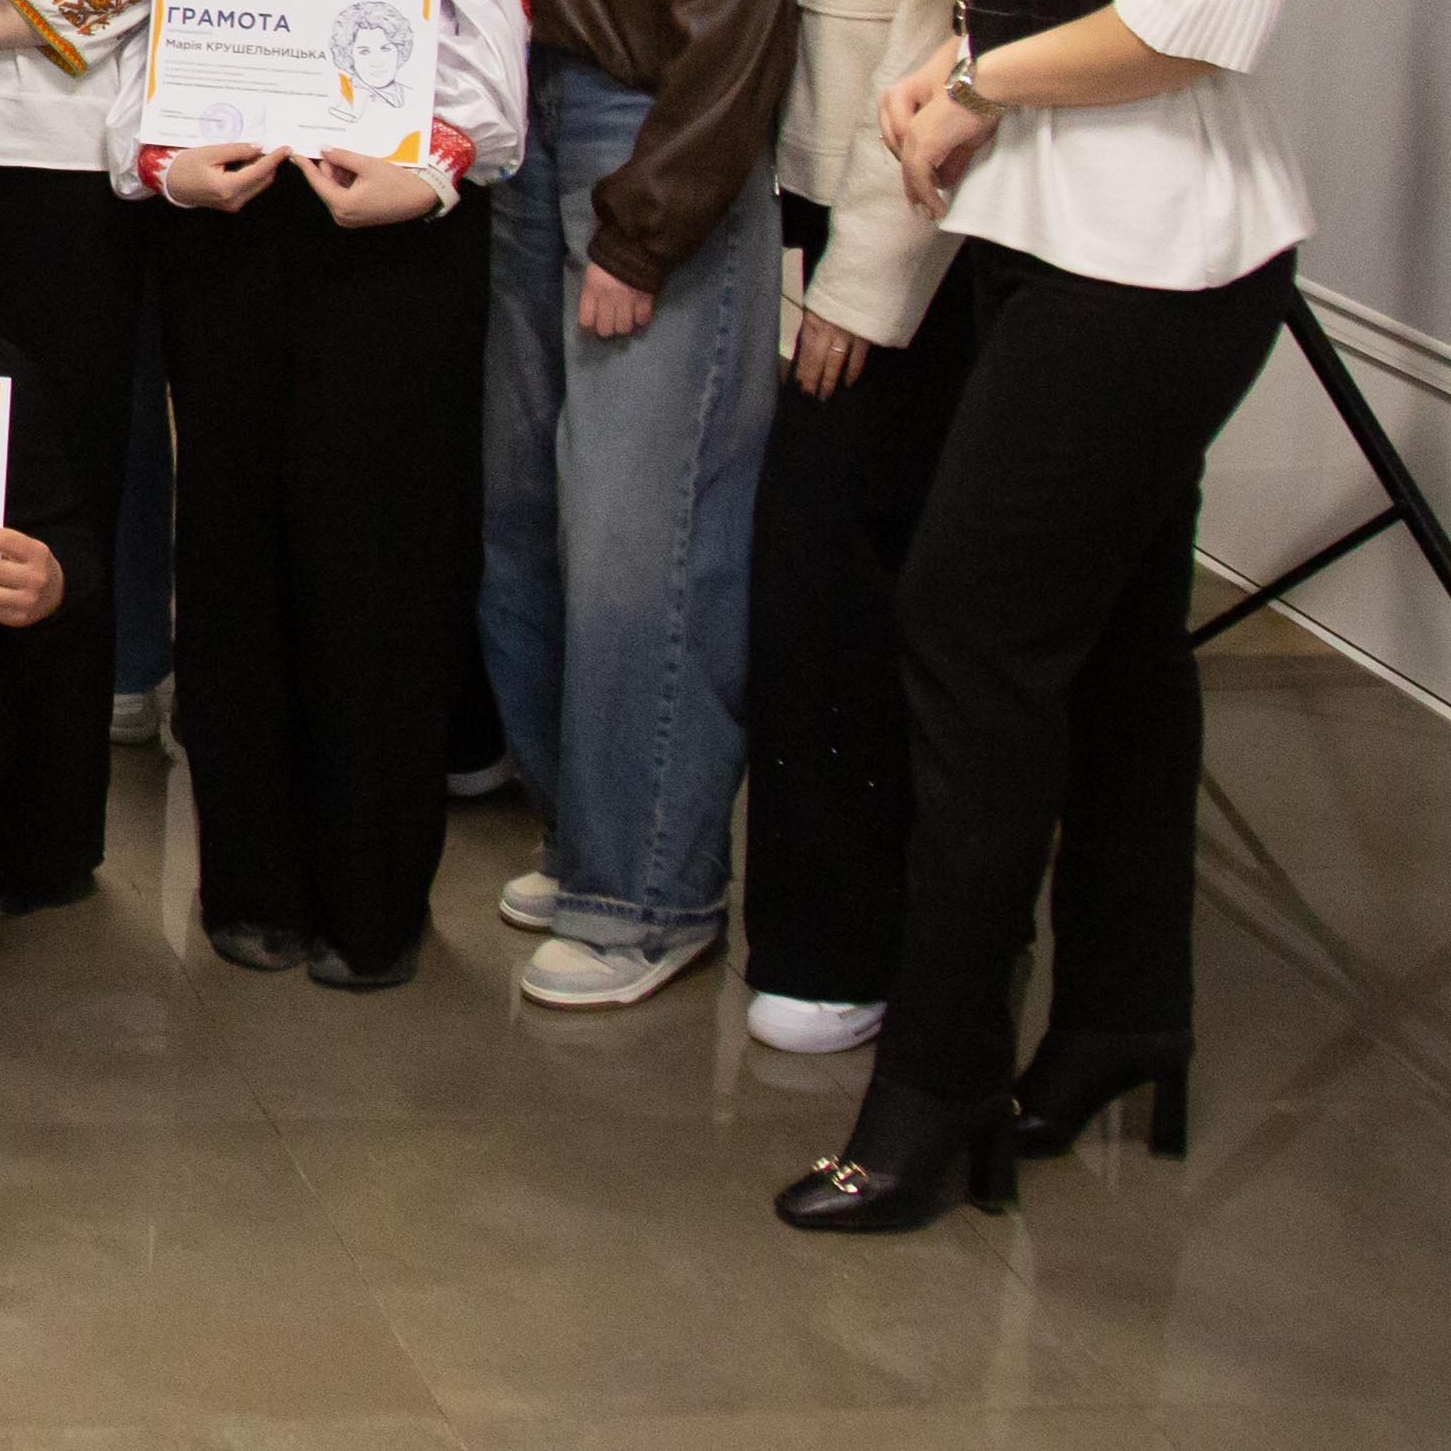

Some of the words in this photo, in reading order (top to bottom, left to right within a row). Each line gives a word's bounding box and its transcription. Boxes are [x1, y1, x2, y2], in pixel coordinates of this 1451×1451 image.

[167, 6, 291, 33] ГРАМОТА
[166, 38, 202, 51] Марія
[206, 41, 327, 60] КРУШЕЛЬНИЦЬКА
